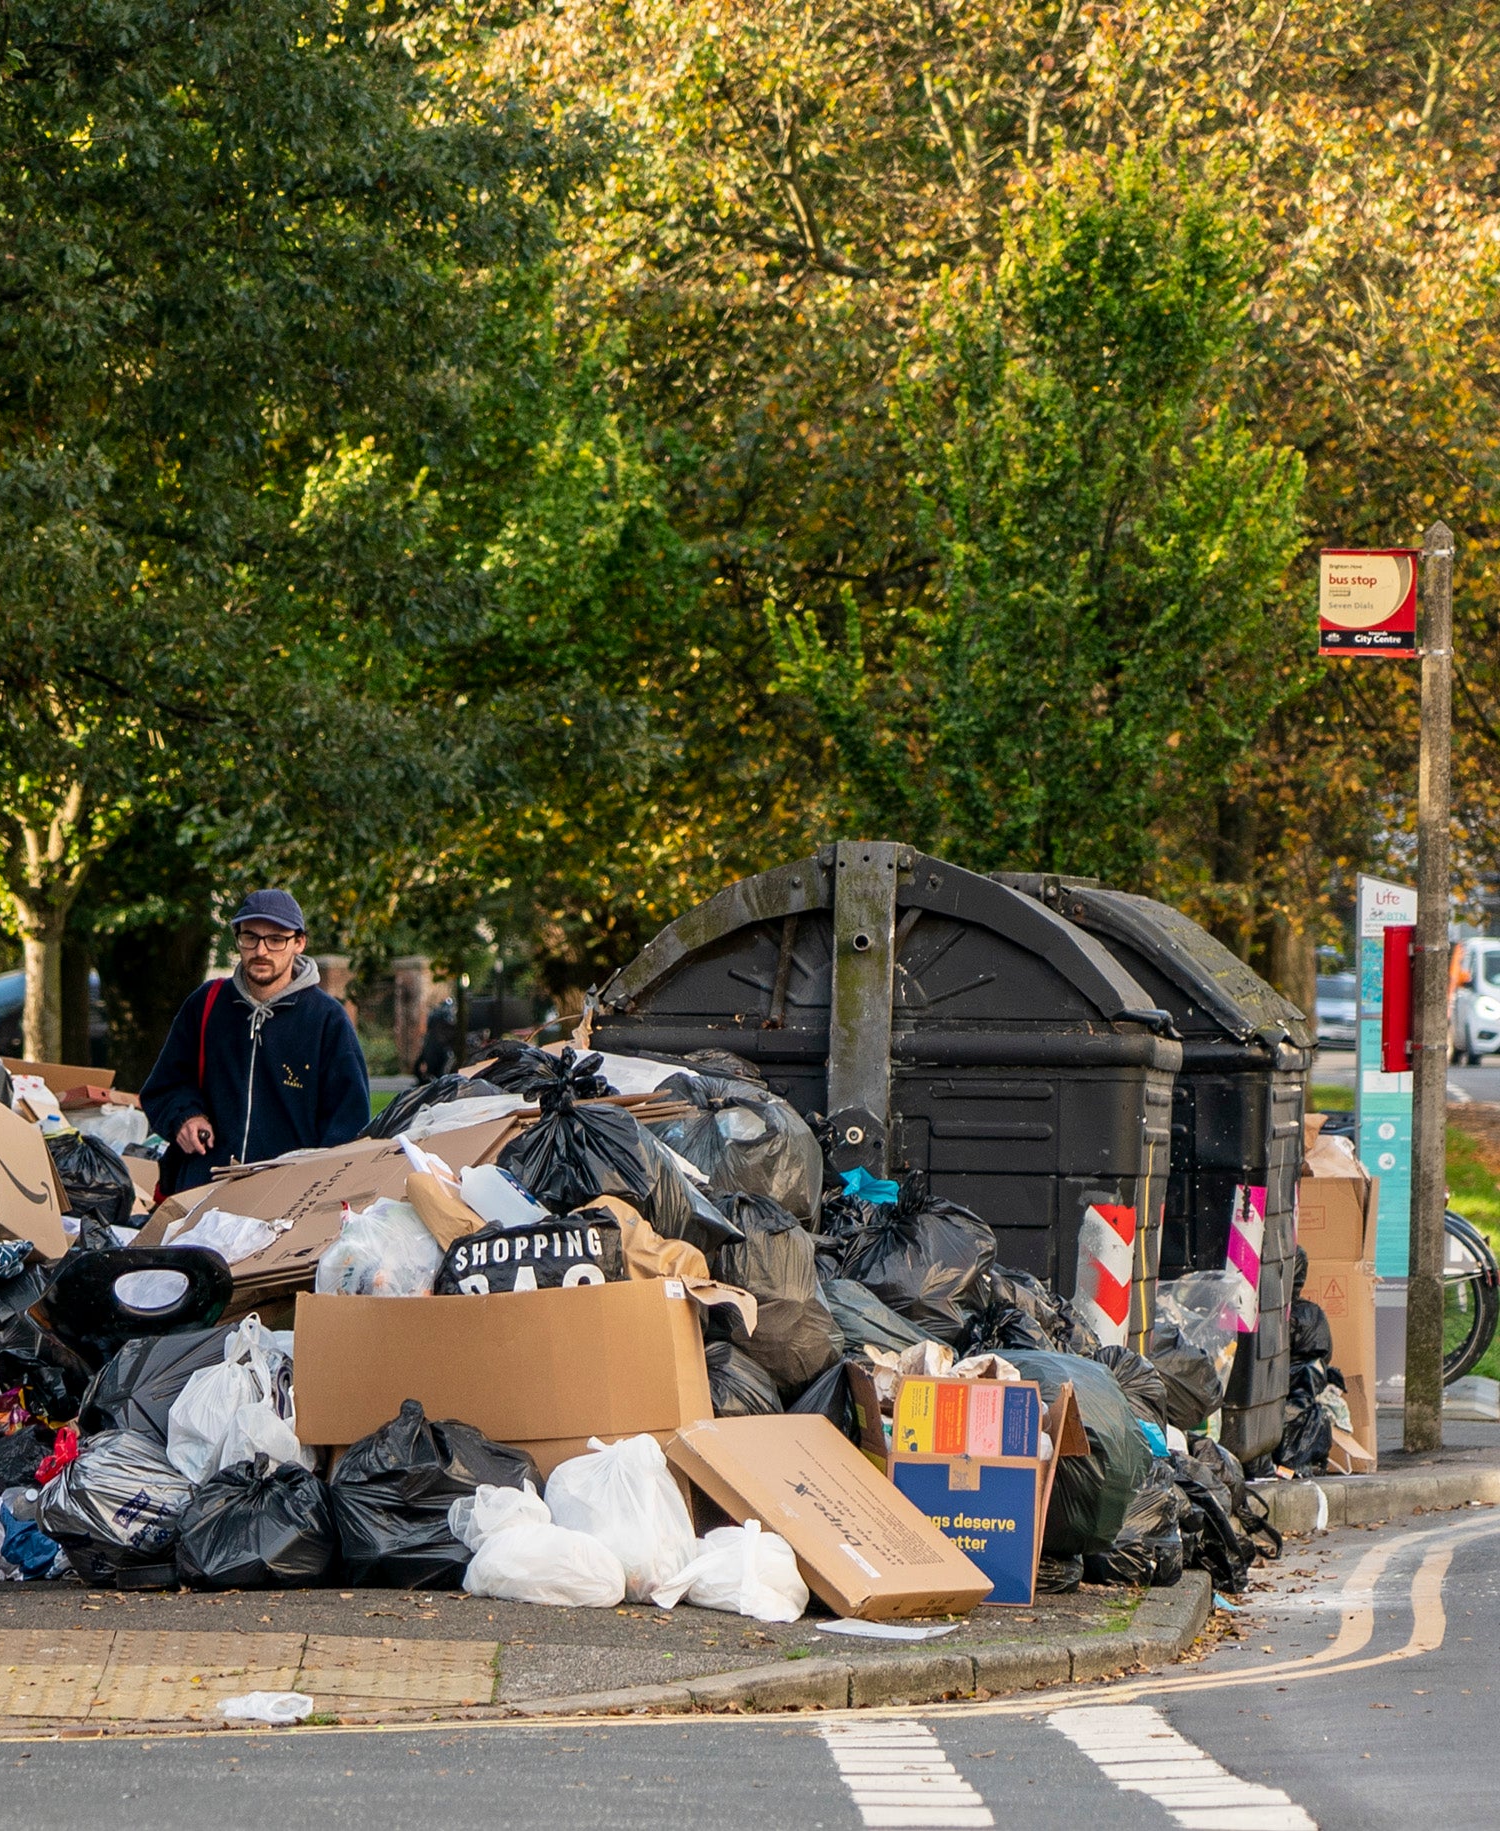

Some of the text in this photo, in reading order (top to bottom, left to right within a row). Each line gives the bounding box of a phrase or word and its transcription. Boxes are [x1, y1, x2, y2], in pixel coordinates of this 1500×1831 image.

[1329, 573, 1377, 588] bus stop
[1354, 634, 1401, 645] City Centre
[454, 1226, 603, 1273] SHOPPING
[953, 1512, 1016, 1531] deserve
